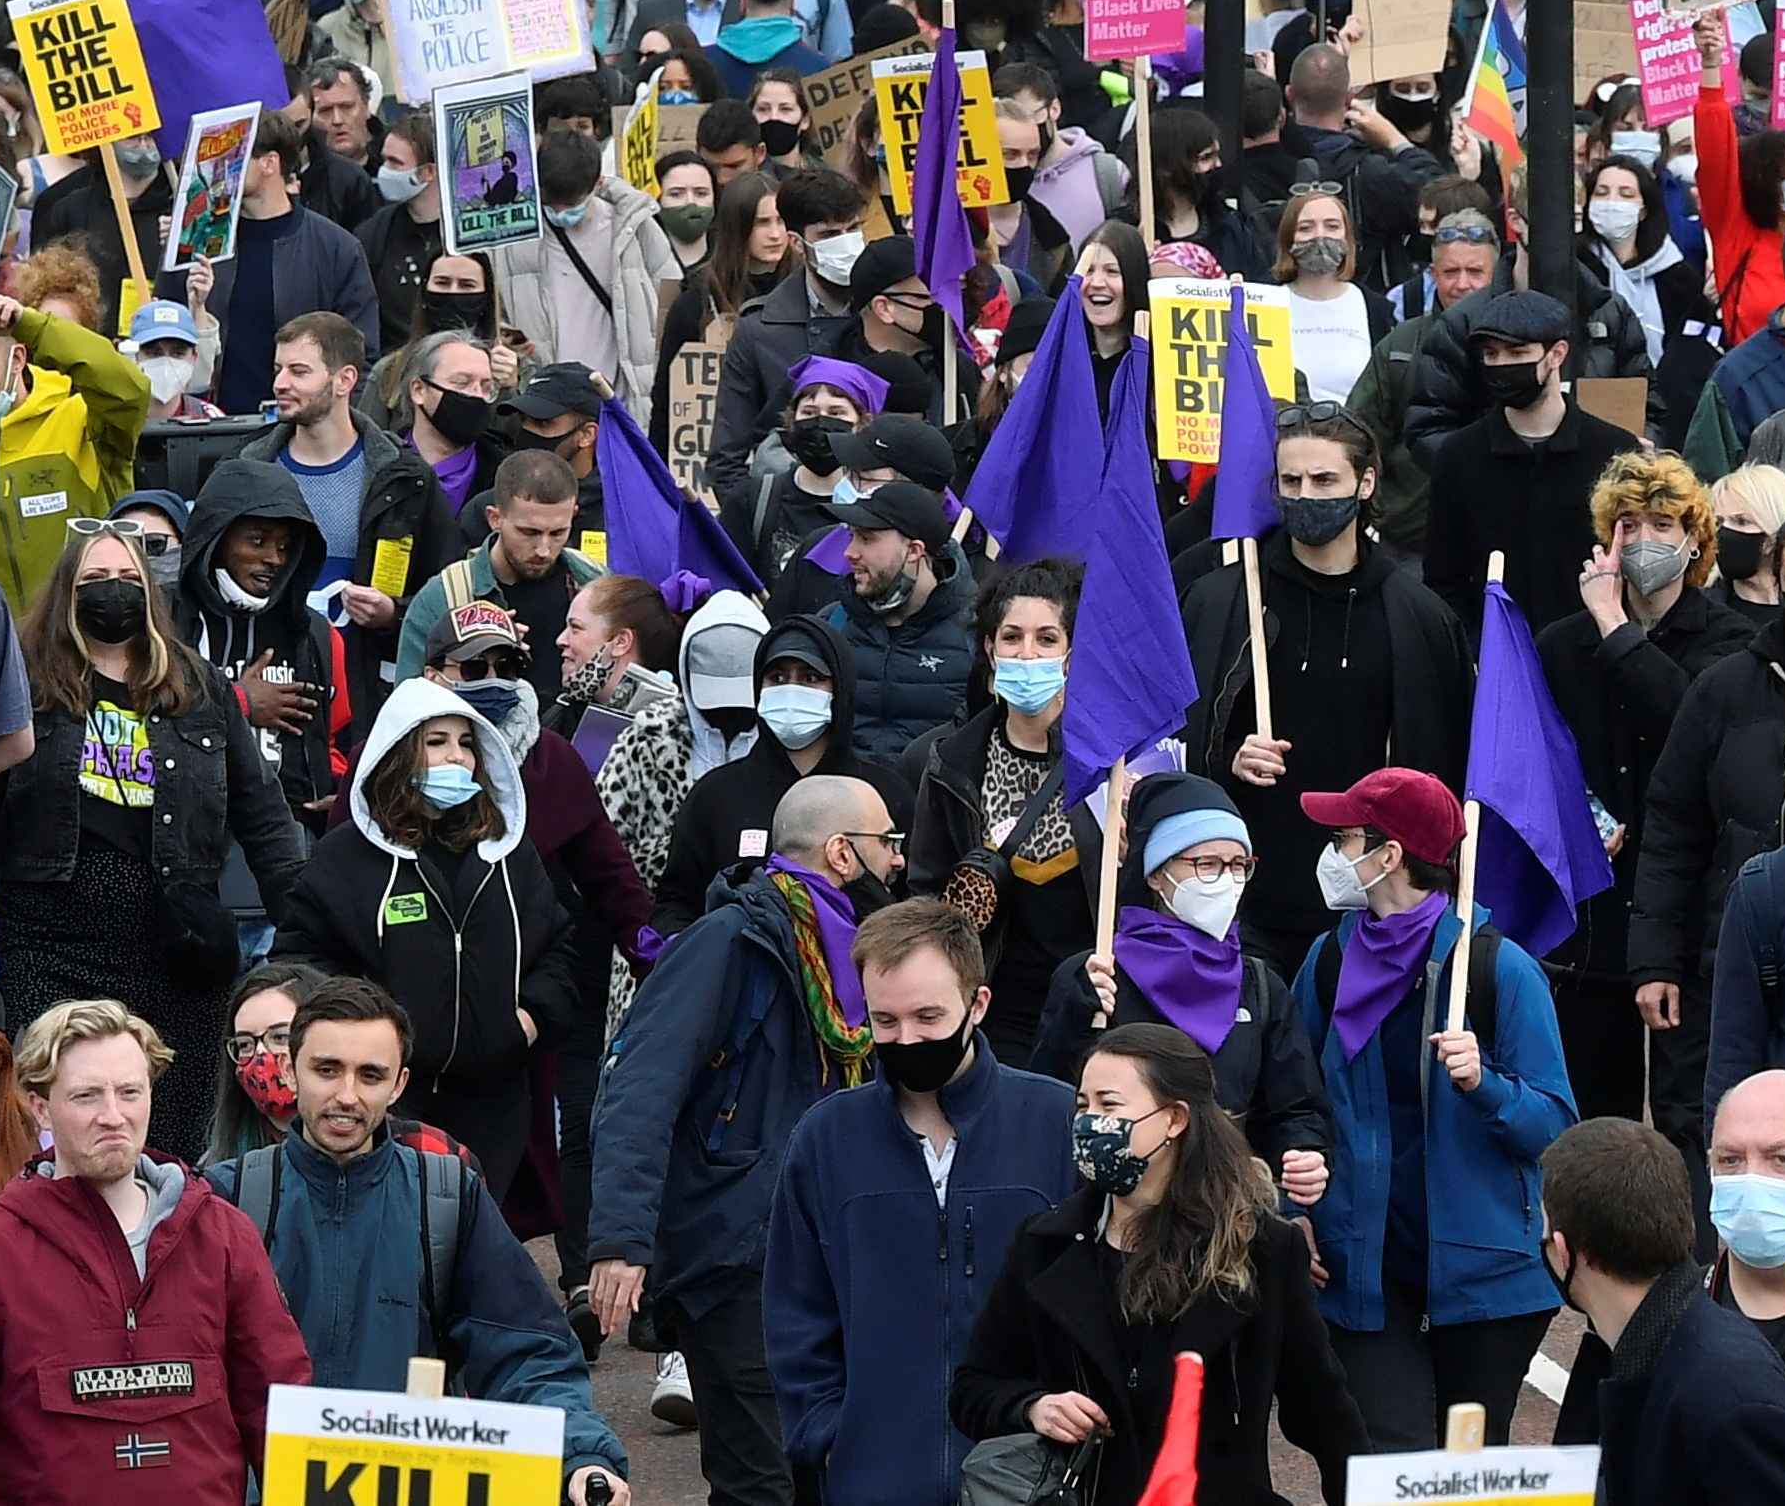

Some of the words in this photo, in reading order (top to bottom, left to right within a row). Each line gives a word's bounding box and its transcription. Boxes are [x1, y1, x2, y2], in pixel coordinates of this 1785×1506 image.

[29, 3, 117, 52] KILL
[1092, 21, 1151, 41] Matter
[35, 36, 114, 82] THE
[422, 28, 492, 73] POLICE
[47, 66, 135, 113] BILL
[55, 113, 76, 127] NO
[78, 99, 120, 121] MORE
[58, 116, 109, 137] POLICE
[61, 124, 122, 149] POWERS
[460, 212, 485, 234] KILL
[510, 203, 536, 224] BILL
[1175, 283, 1223, 300] Socialist
[1175, 415, 1198, 430] NO
[320, 1407, 421, 1440] Socialist
[424, 1416, 511, 1446] Worker
[1395, 1470, 1480, 1499] Socialist
[1481, 1467, 1550, 1493] Worker
